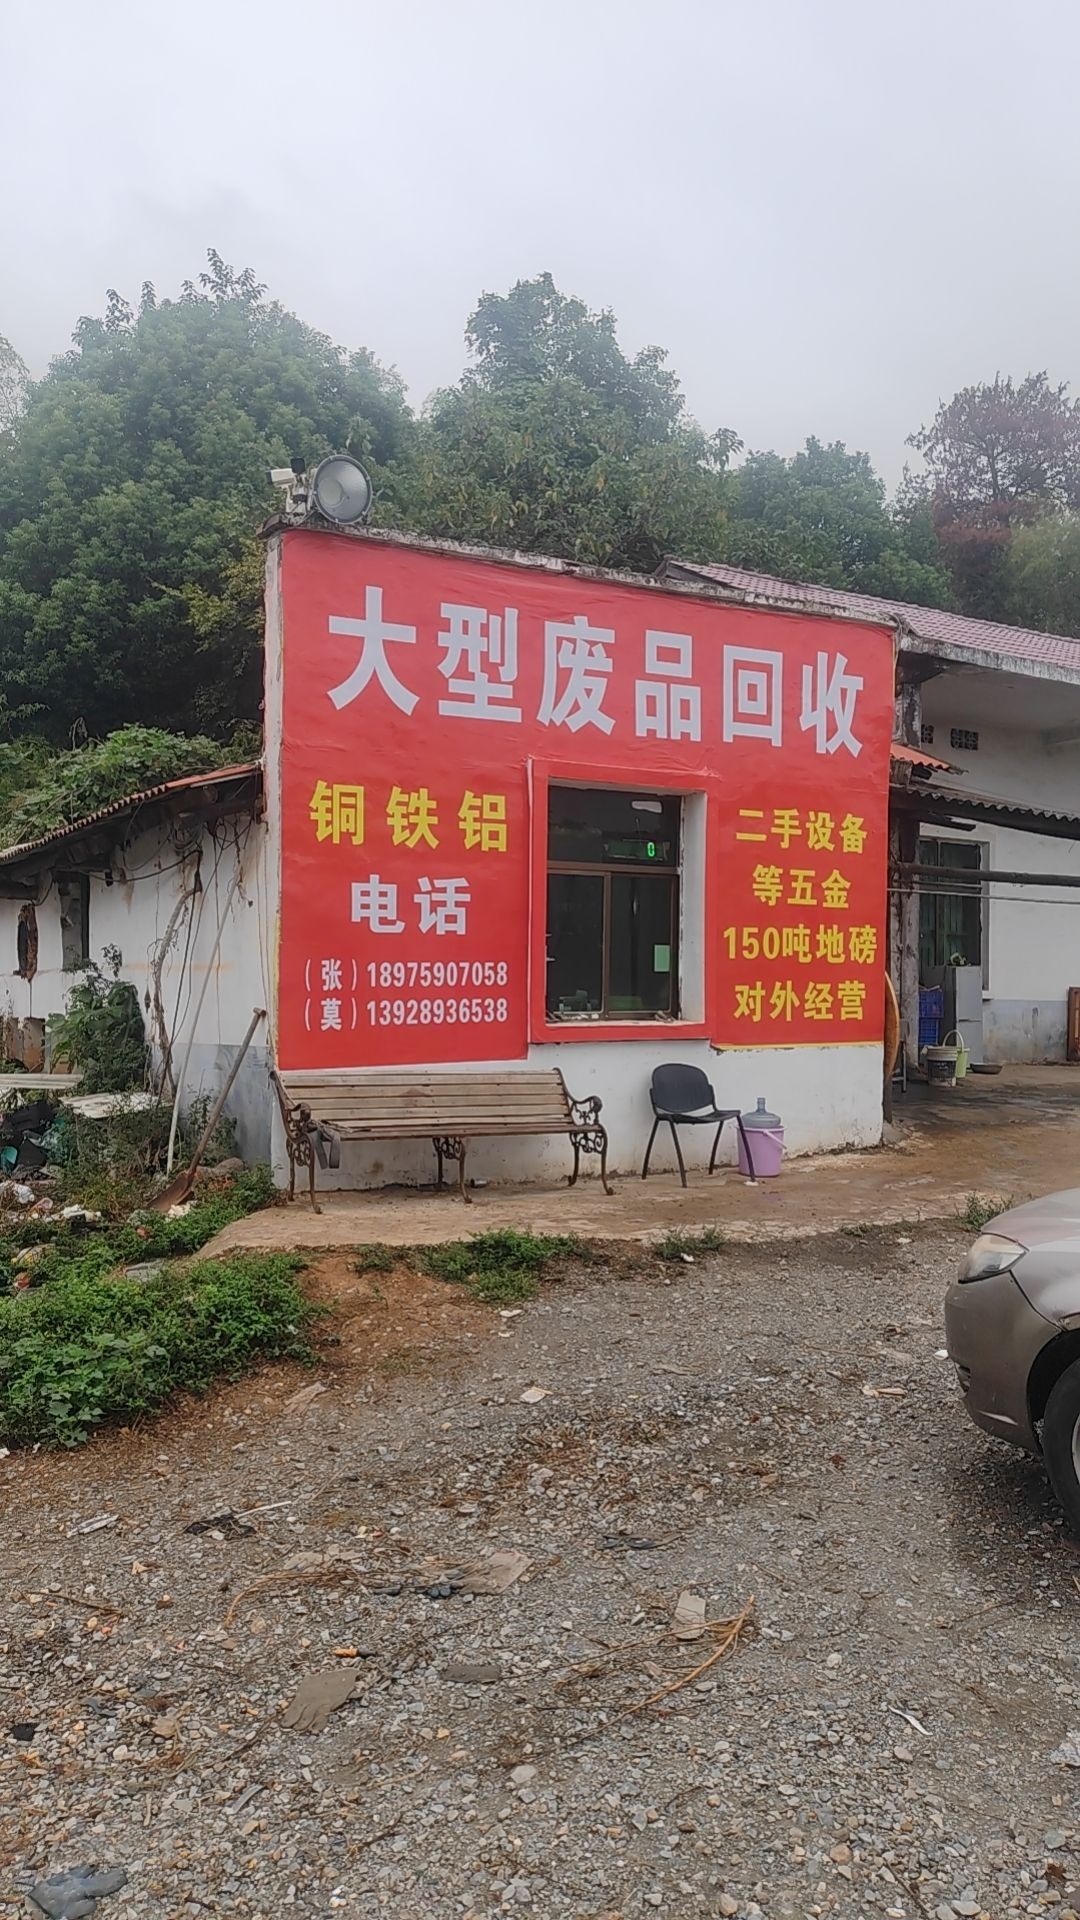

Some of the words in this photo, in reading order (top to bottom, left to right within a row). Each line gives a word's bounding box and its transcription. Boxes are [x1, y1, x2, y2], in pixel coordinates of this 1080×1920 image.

[327, 586, 864, 757] 大型废品回收
[308, 779, 507, 852] 铜铁铝
[736, 808, 868, 854] 二手设备
[351, 874, 471, 935] 电话
[752, 863, 852, 909] 等五金
[723, 923, 878, 964] 150吨地磅
[733, 980, 867, 1022] 对外经营
